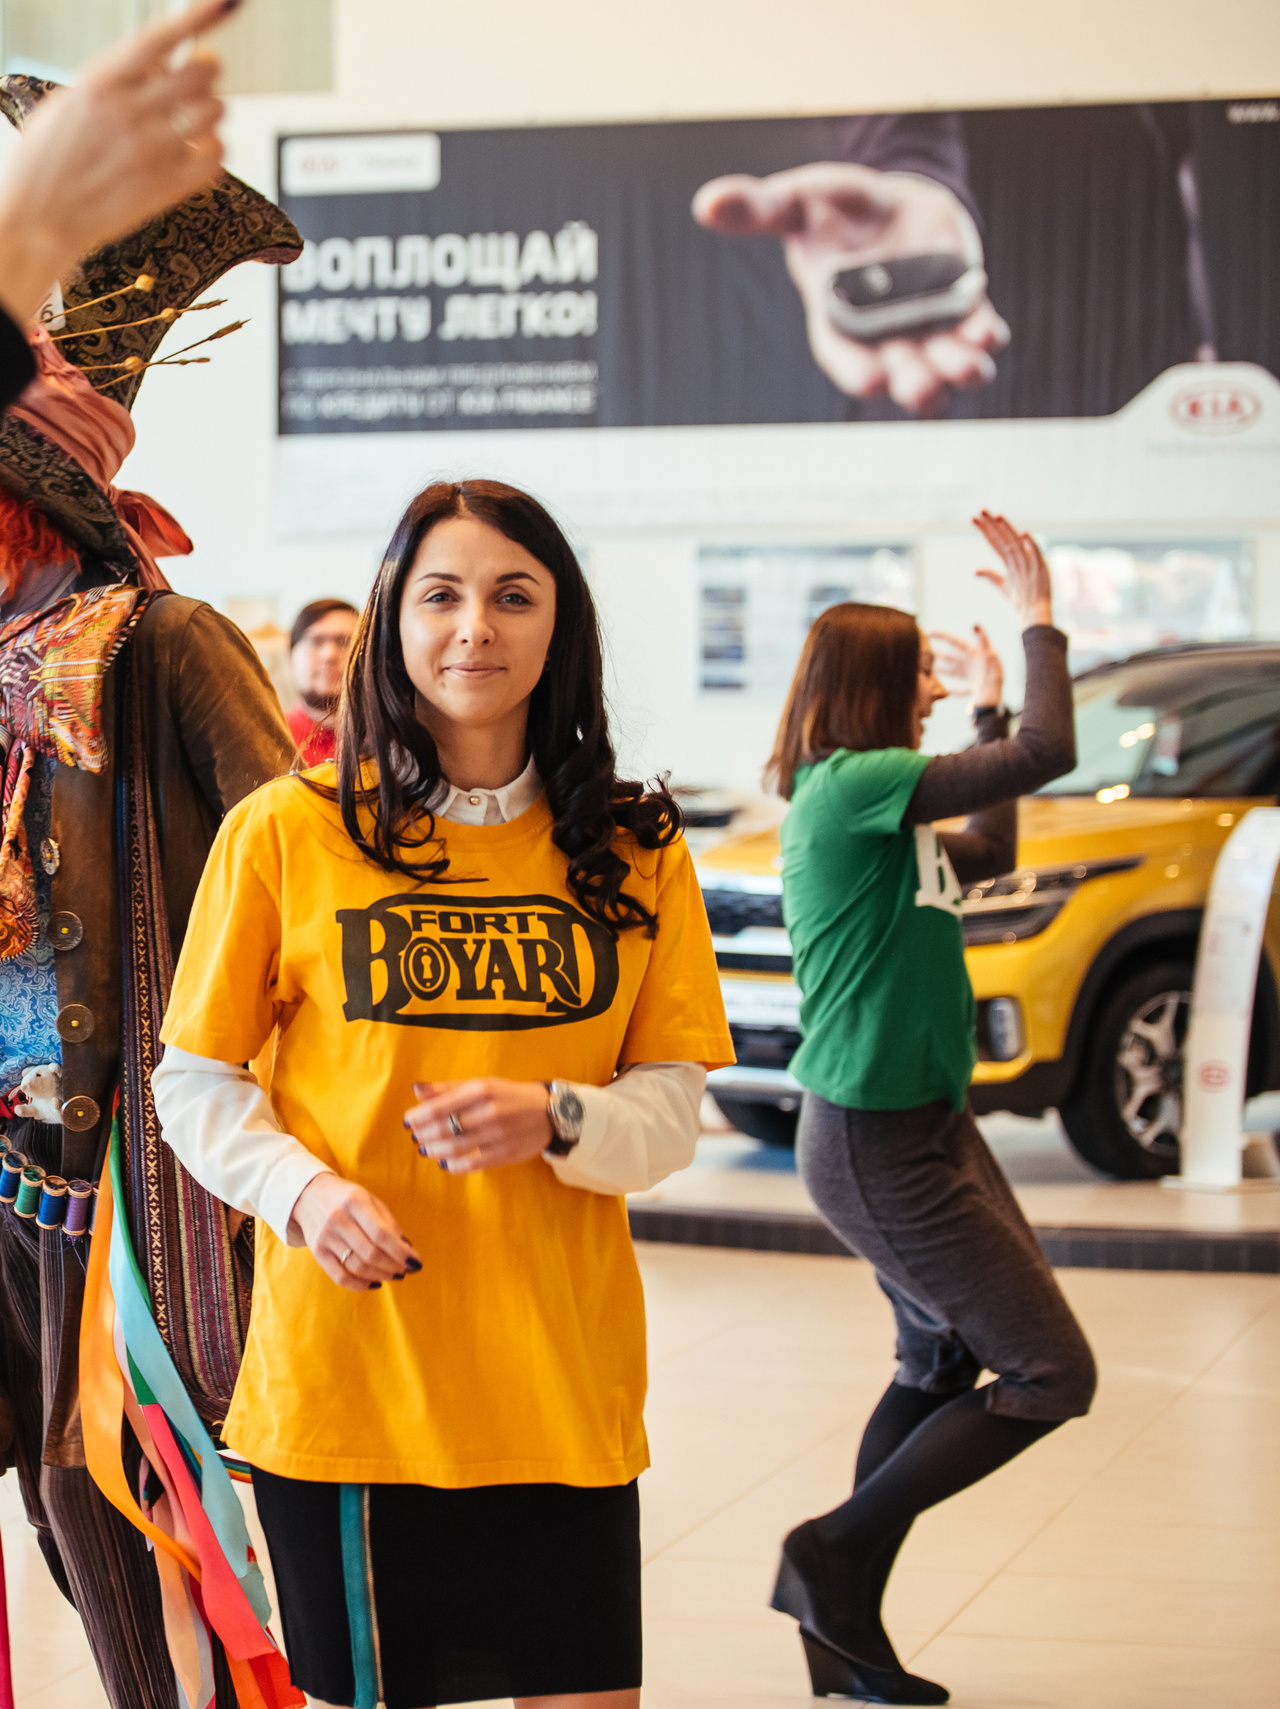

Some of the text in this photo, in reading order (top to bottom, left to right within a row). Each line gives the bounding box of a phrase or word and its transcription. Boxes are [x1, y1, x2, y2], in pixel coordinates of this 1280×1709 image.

[283, 298, 430, 342] МЕЧТУ
[410, 909, 536, 934] FORT
[335, 893, 620, 1032] BOYARD
